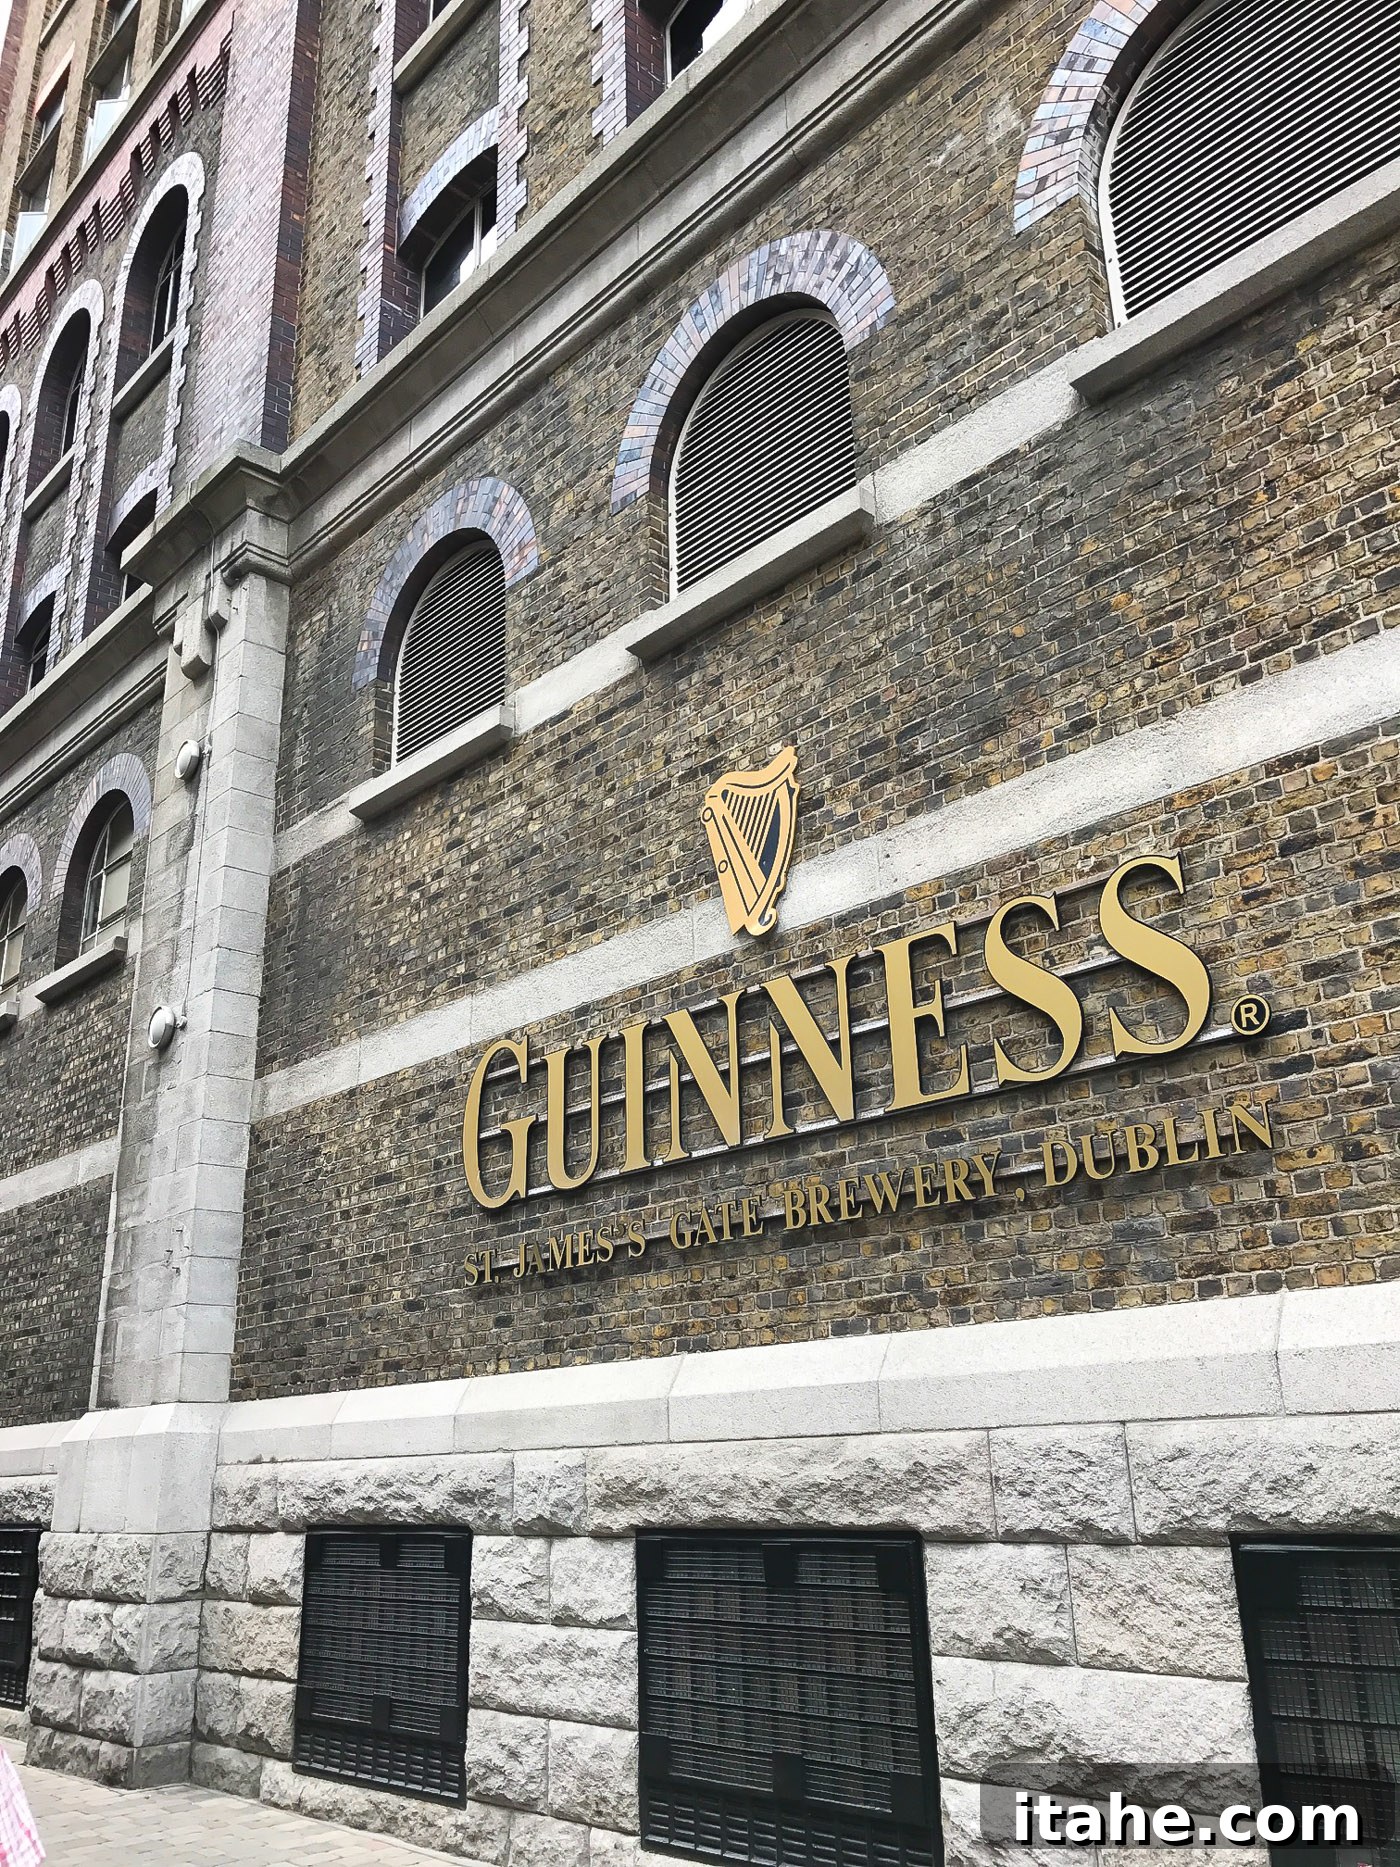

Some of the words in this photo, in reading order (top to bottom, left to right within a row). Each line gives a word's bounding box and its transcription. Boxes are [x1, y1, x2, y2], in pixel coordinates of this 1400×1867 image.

[463, 1250, 500, 1288] ST.
[669, 1195, 764, 1250] GATE
[1042, 1099, 1274, 1188] DUBLIN
